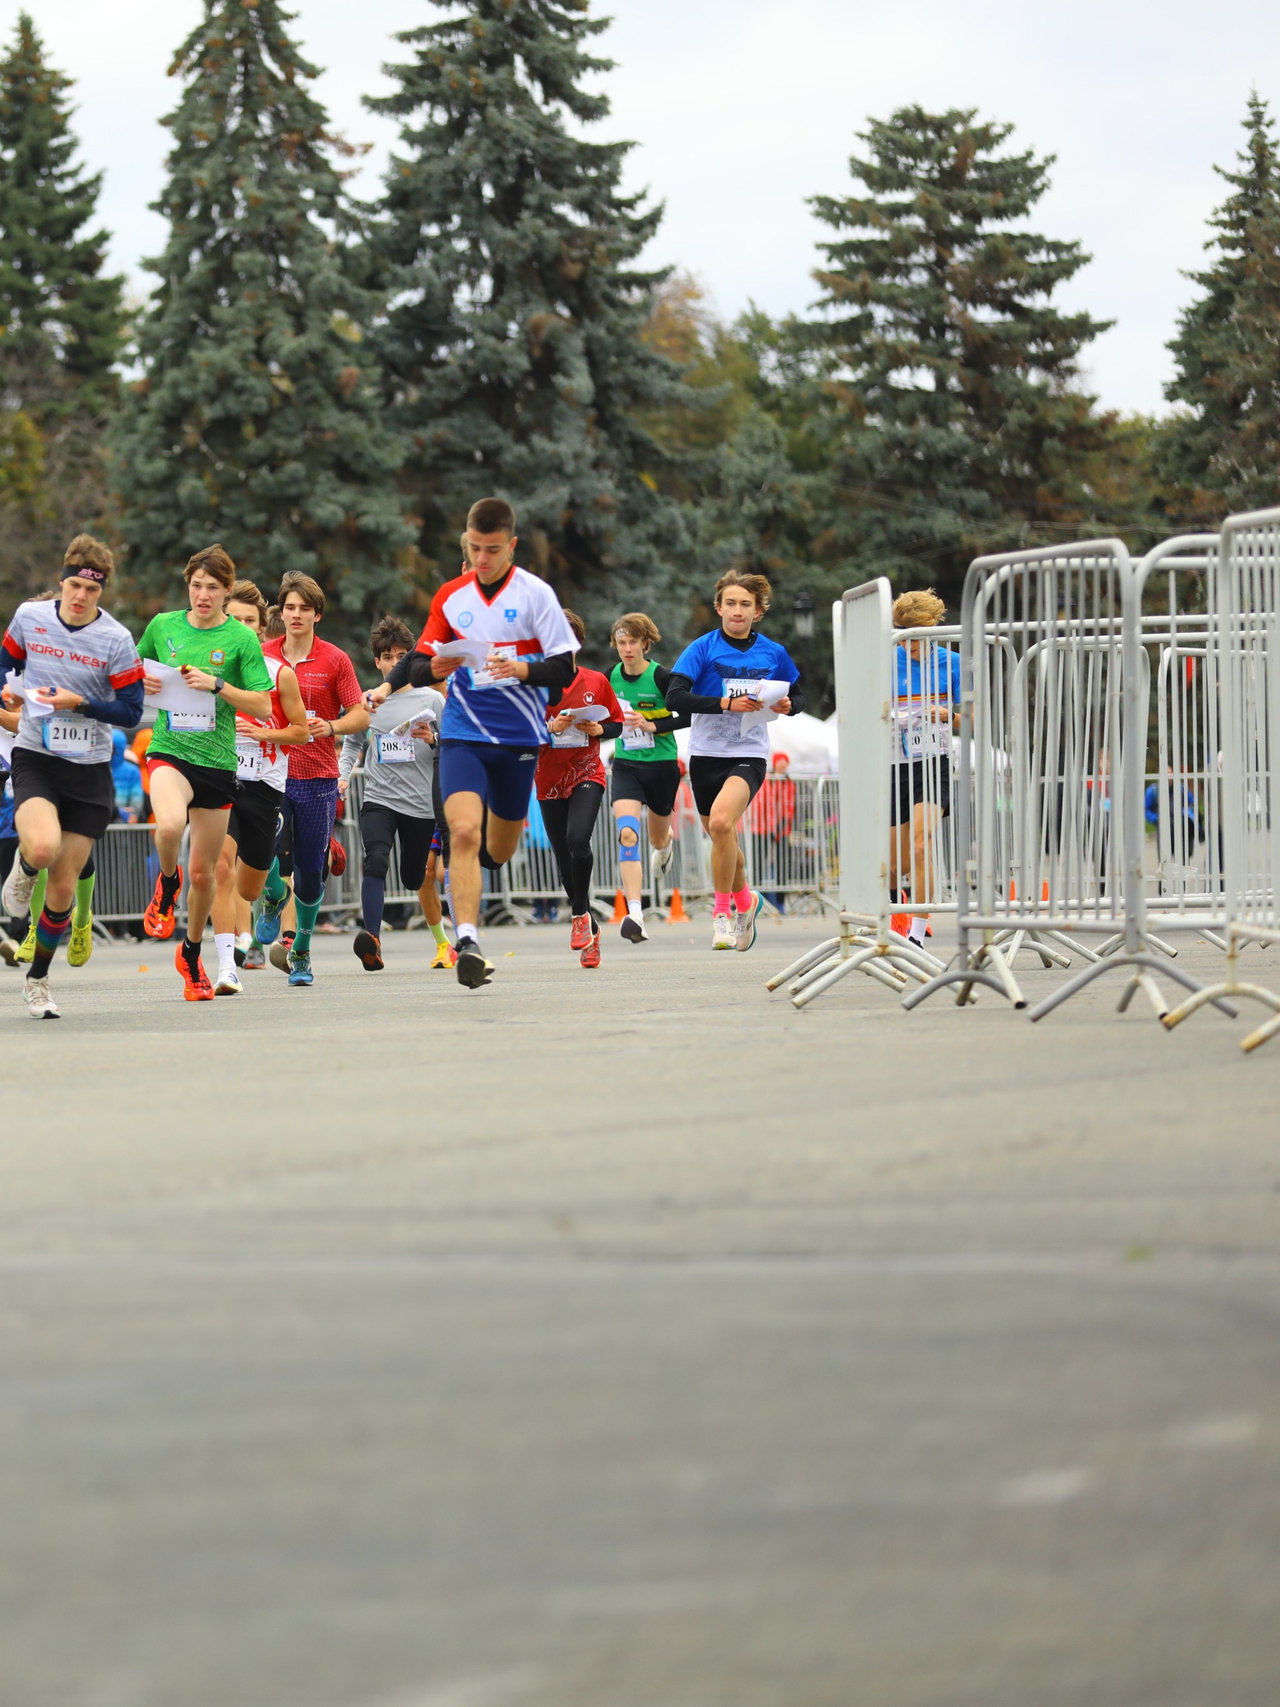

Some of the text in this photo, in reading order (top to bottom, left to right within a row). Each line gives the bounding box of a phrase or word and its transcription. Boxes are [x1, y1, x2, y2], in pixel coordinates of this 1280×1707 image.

[26, 641, 108, 669] NORD WEST
[52, 727, 89, 741] 210.1
[237, 755, 255, 768] 9.1
